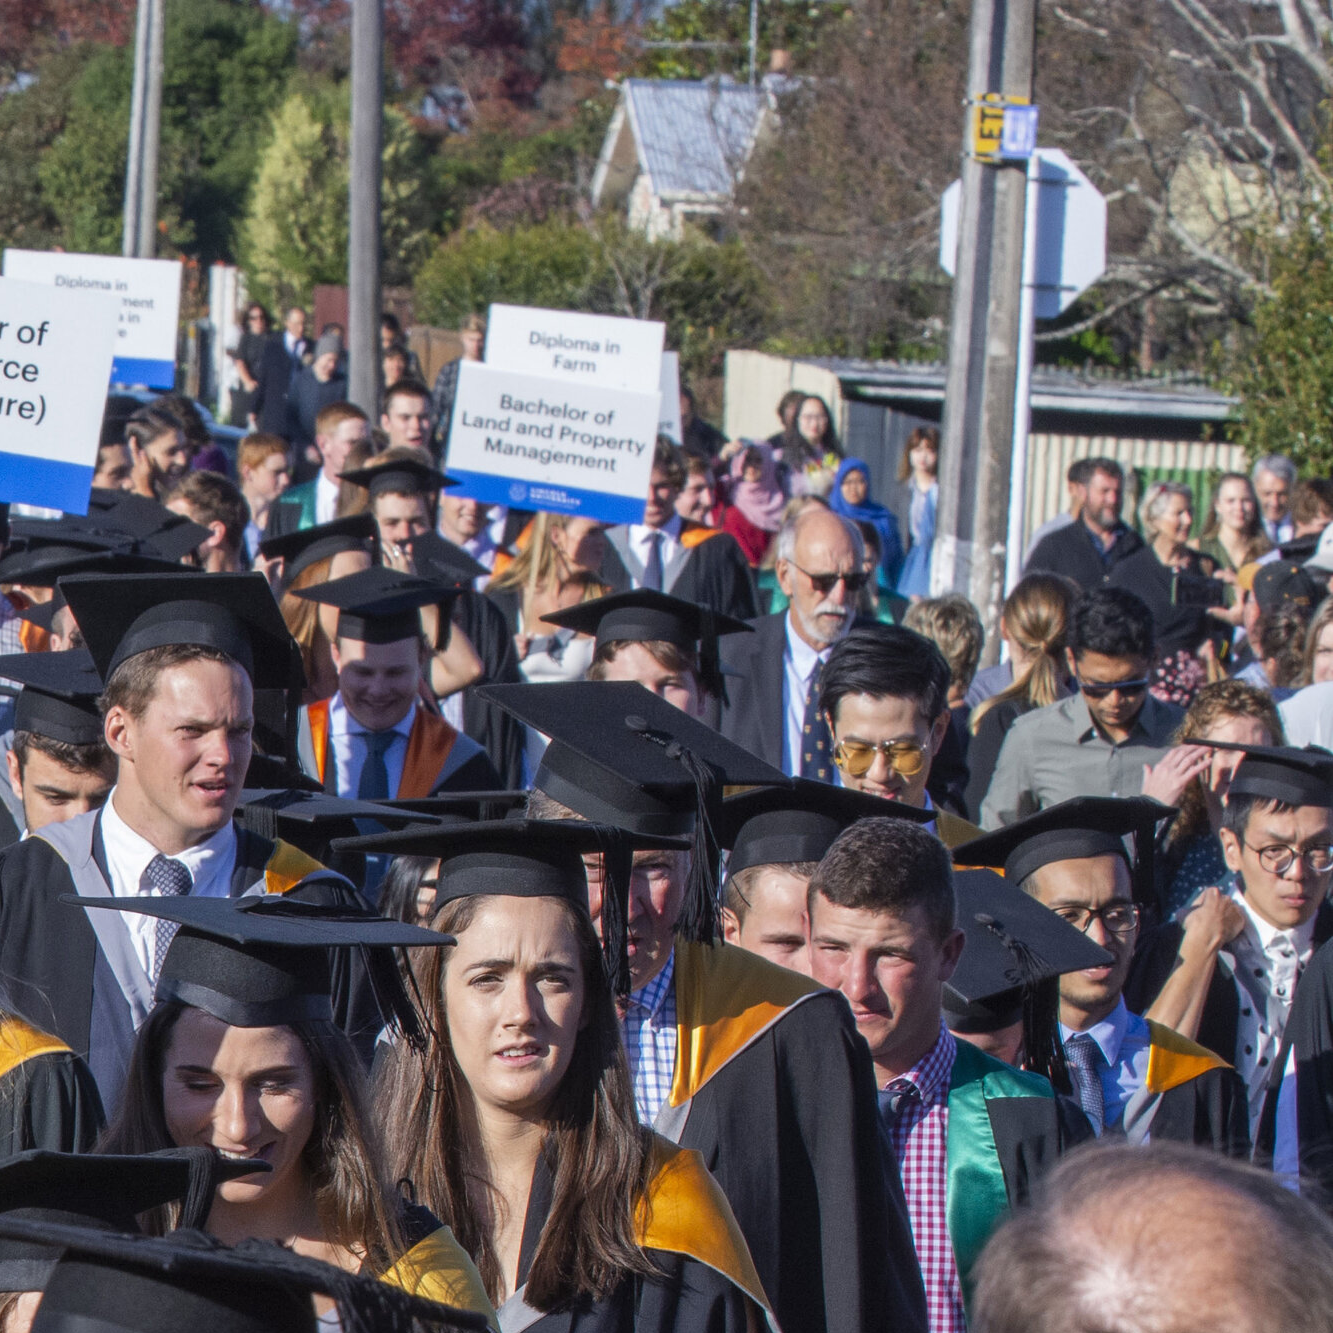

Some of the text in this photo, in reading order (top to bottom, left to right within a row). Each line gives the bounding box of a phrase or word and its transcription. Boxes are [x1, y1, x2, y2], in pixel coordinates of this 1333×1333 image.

[54, 274, 128, 291] Diploma in
[17, 321, 49, 346] of
[529, 331, 620, 354] Diploma in
[552, 354, 597, 373] Farm
[500, 394, 615, 425] Bachelor of
[462, 411, 646, 457] Land and Property
[484, 438, 617, 472] Management
